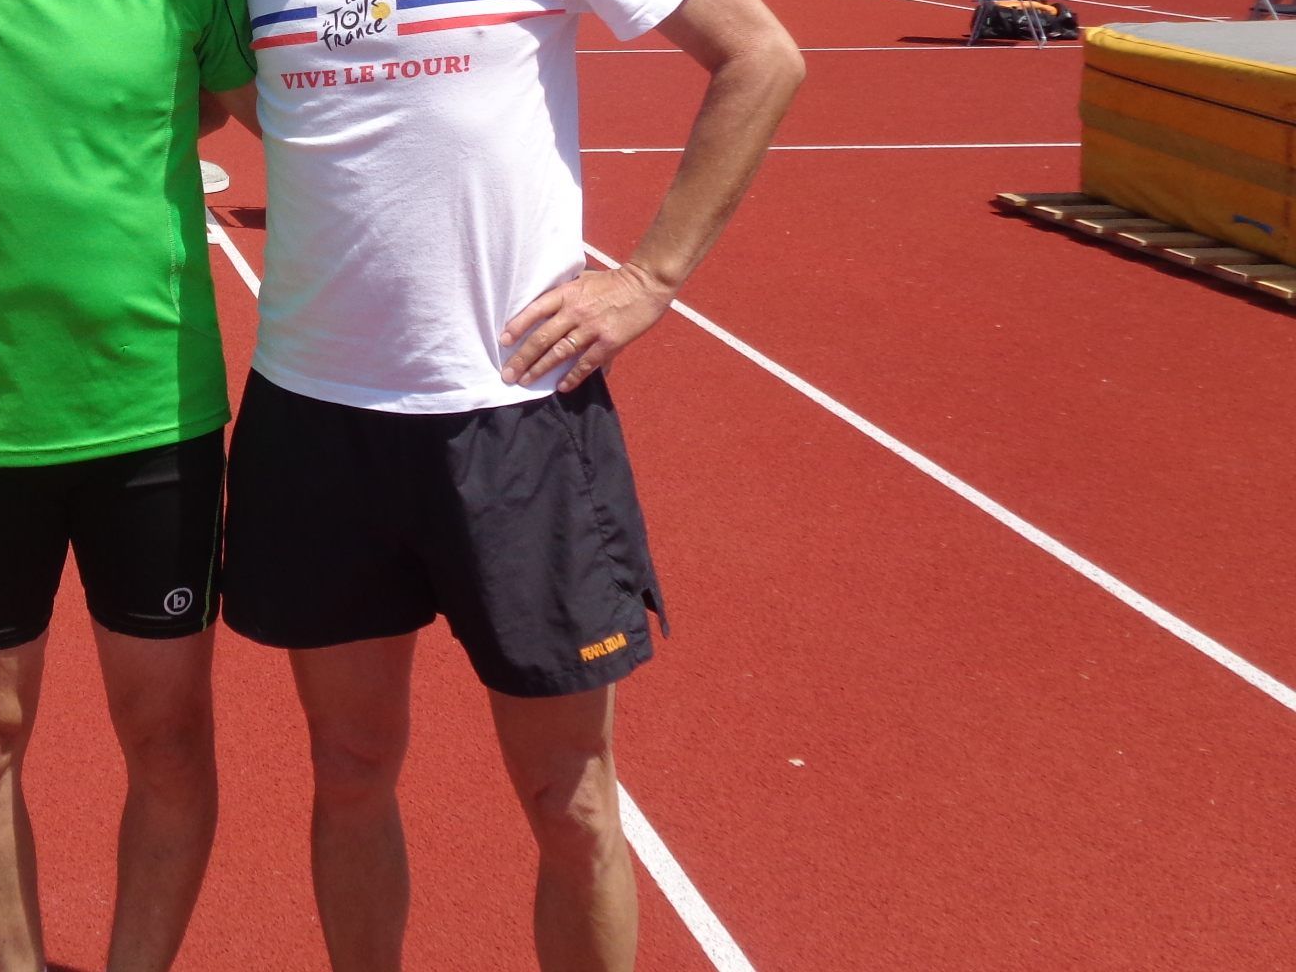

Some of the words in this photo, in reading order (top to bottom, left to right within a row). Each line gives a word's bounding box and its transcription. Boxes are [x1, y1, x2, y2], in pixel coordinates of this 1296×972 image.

[281, 69, 337, 90] VIVE
[344, 65, 375, 85] LE
[382, 55, 471, 81] TOUR!
